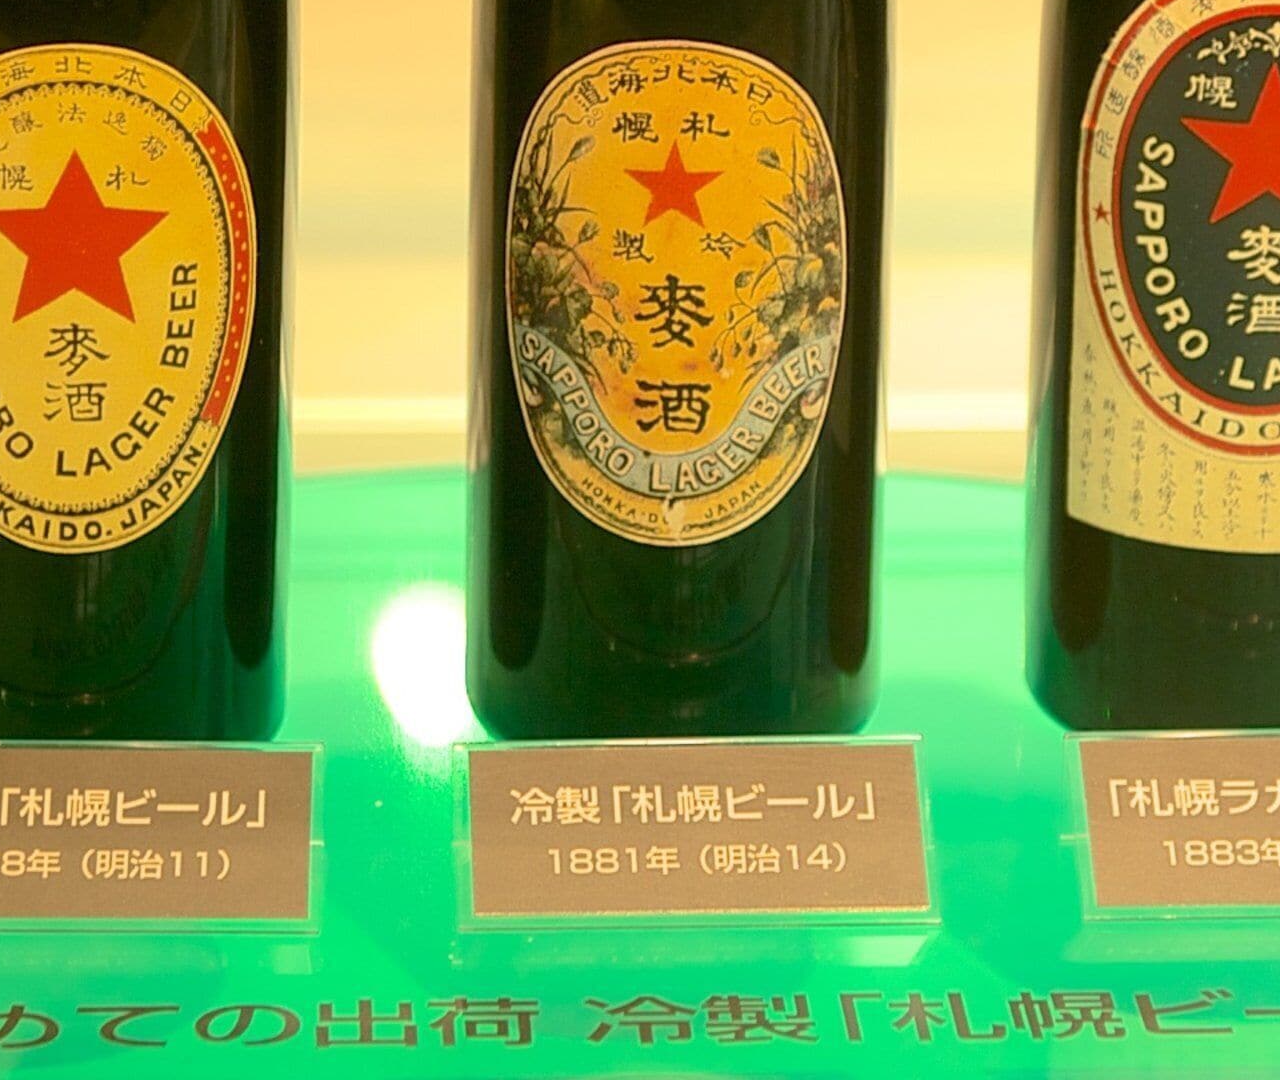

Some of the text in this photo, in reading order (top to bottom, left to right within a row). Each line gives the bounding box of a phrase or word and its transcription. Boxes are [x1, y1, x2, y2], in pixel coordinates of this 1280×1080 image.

[1134, 135, 1210, 360] SAPPORO
[55, 386, 175, 477] LAGER
[160, 263, 198, 369] BEER
[521, 333, 826, 495] SAPPORO LAGER BEER
[704, 480, 761, 520] JAPAN
[510, 782, 876, 826] 冷製「札幌ビール」
